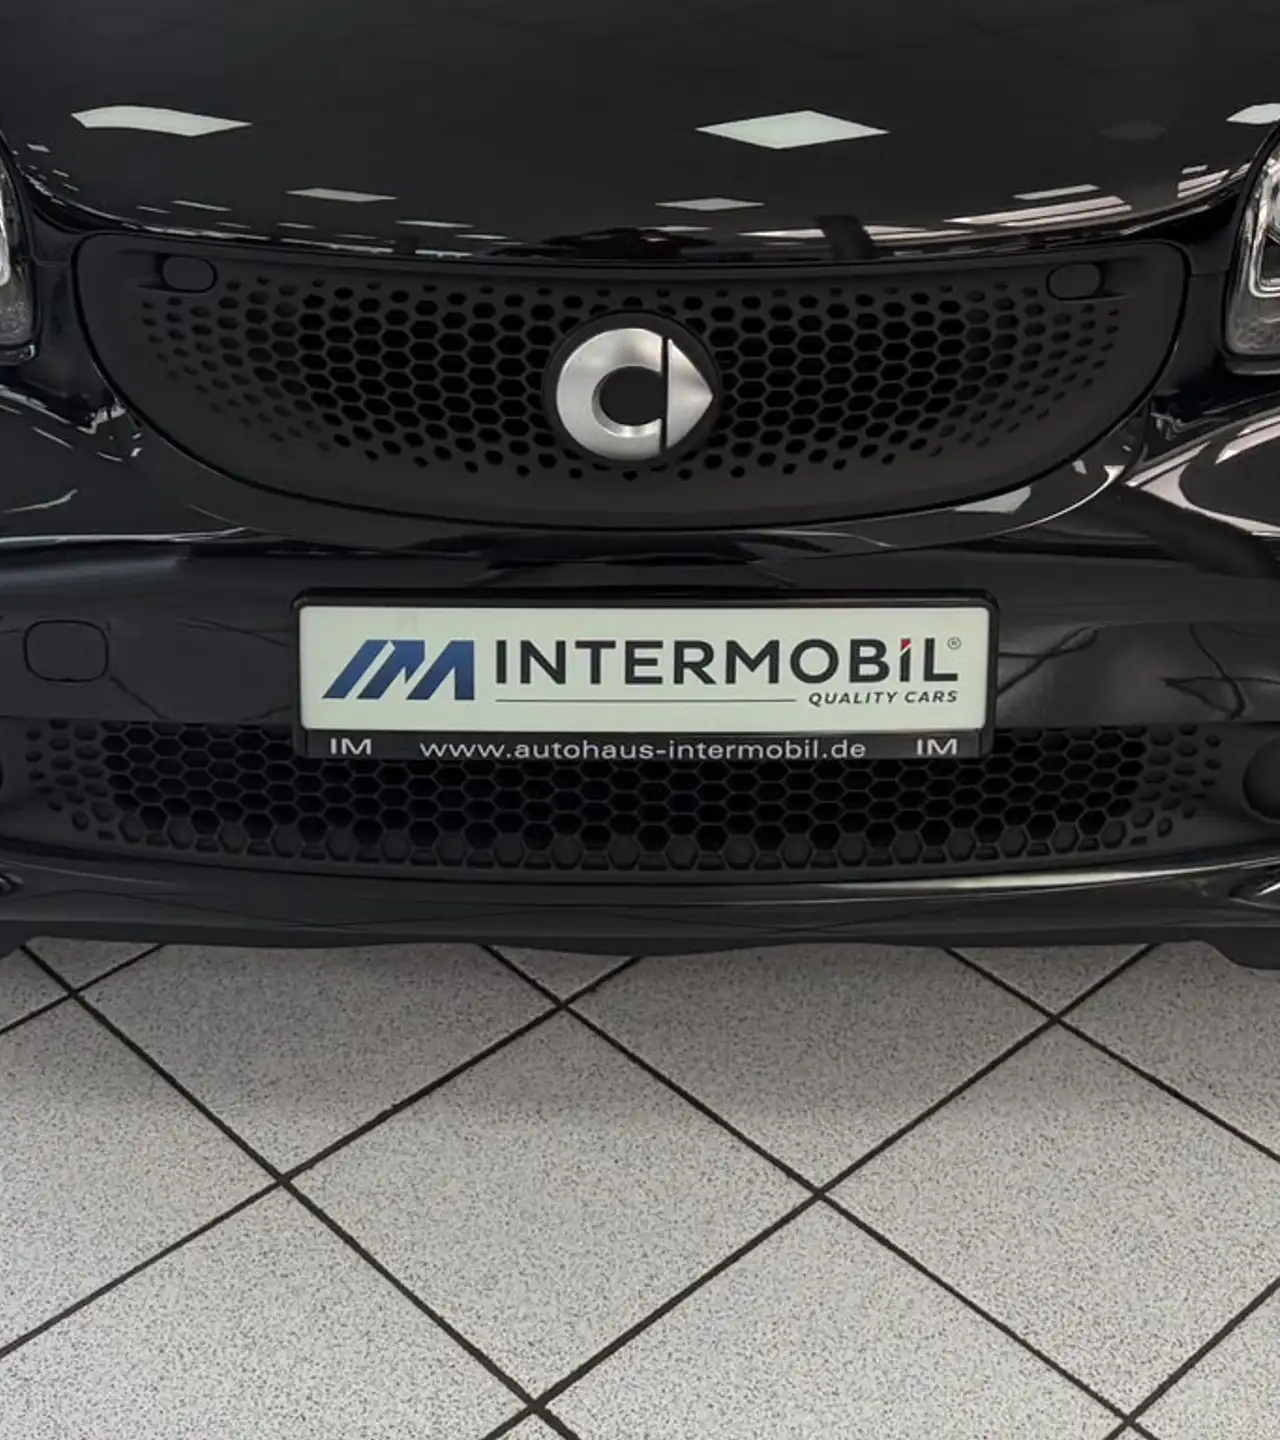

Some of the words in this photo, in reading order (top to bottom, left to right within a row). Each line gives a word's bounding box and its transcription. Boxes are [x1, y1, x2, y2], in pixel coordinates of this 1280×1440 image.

[808, 690, 898, 708] QUALITY
[904, 690, 958, 703] CARS
[329, 737, 372, 756] IM
[419, 739, 867, 760] www.autohaus-intermobil.de
[915, 738, 958, 756] IM
